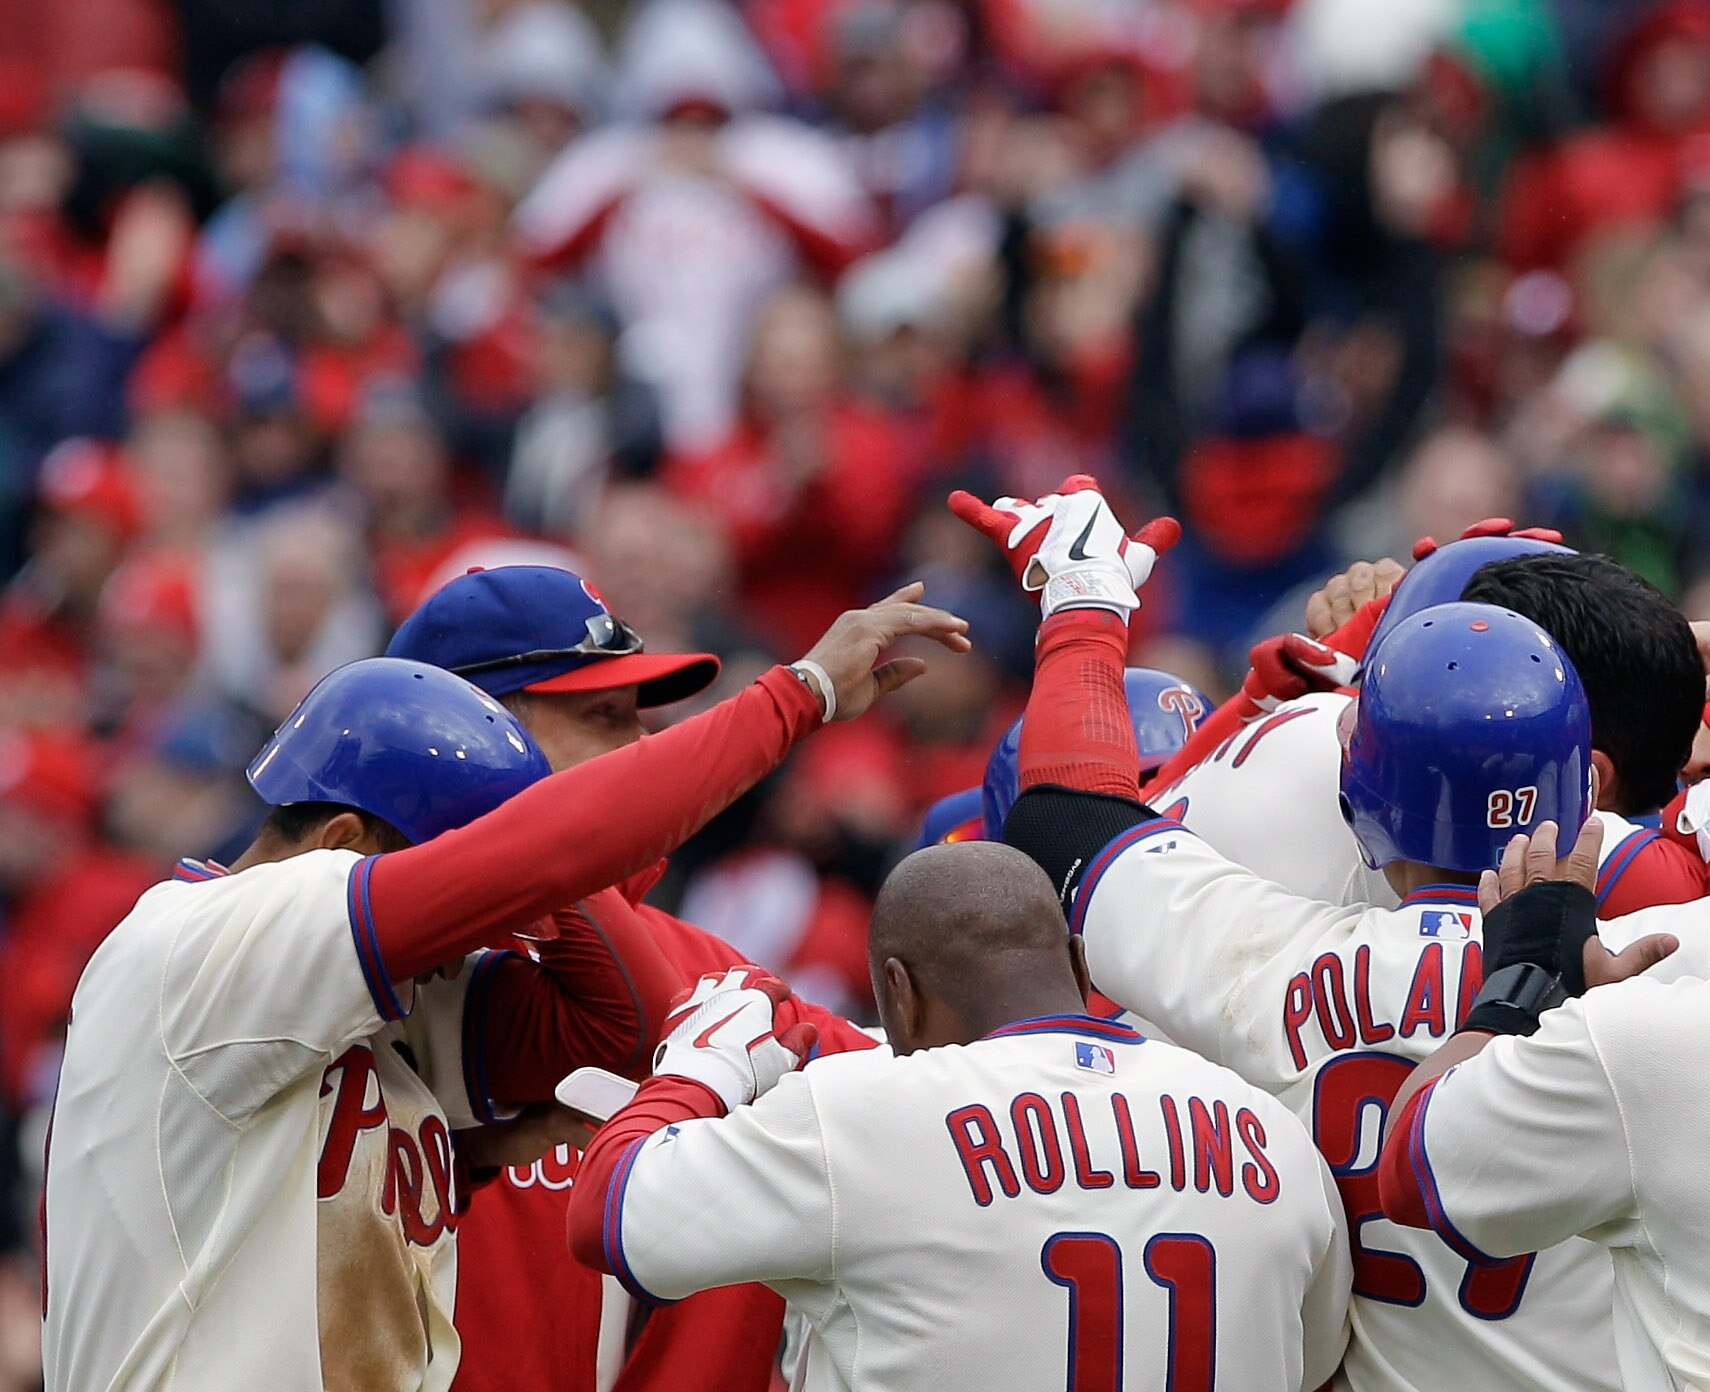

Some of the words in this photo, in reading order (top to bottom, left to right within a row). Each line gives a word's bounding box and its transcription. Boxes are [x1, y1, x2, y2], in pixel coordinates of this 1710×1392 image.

[1487, 785, 1538, 828] 27
[945, 1091, 1281, 1207] ROLLINS
[1313, 1051, 1537, 1320] 2
